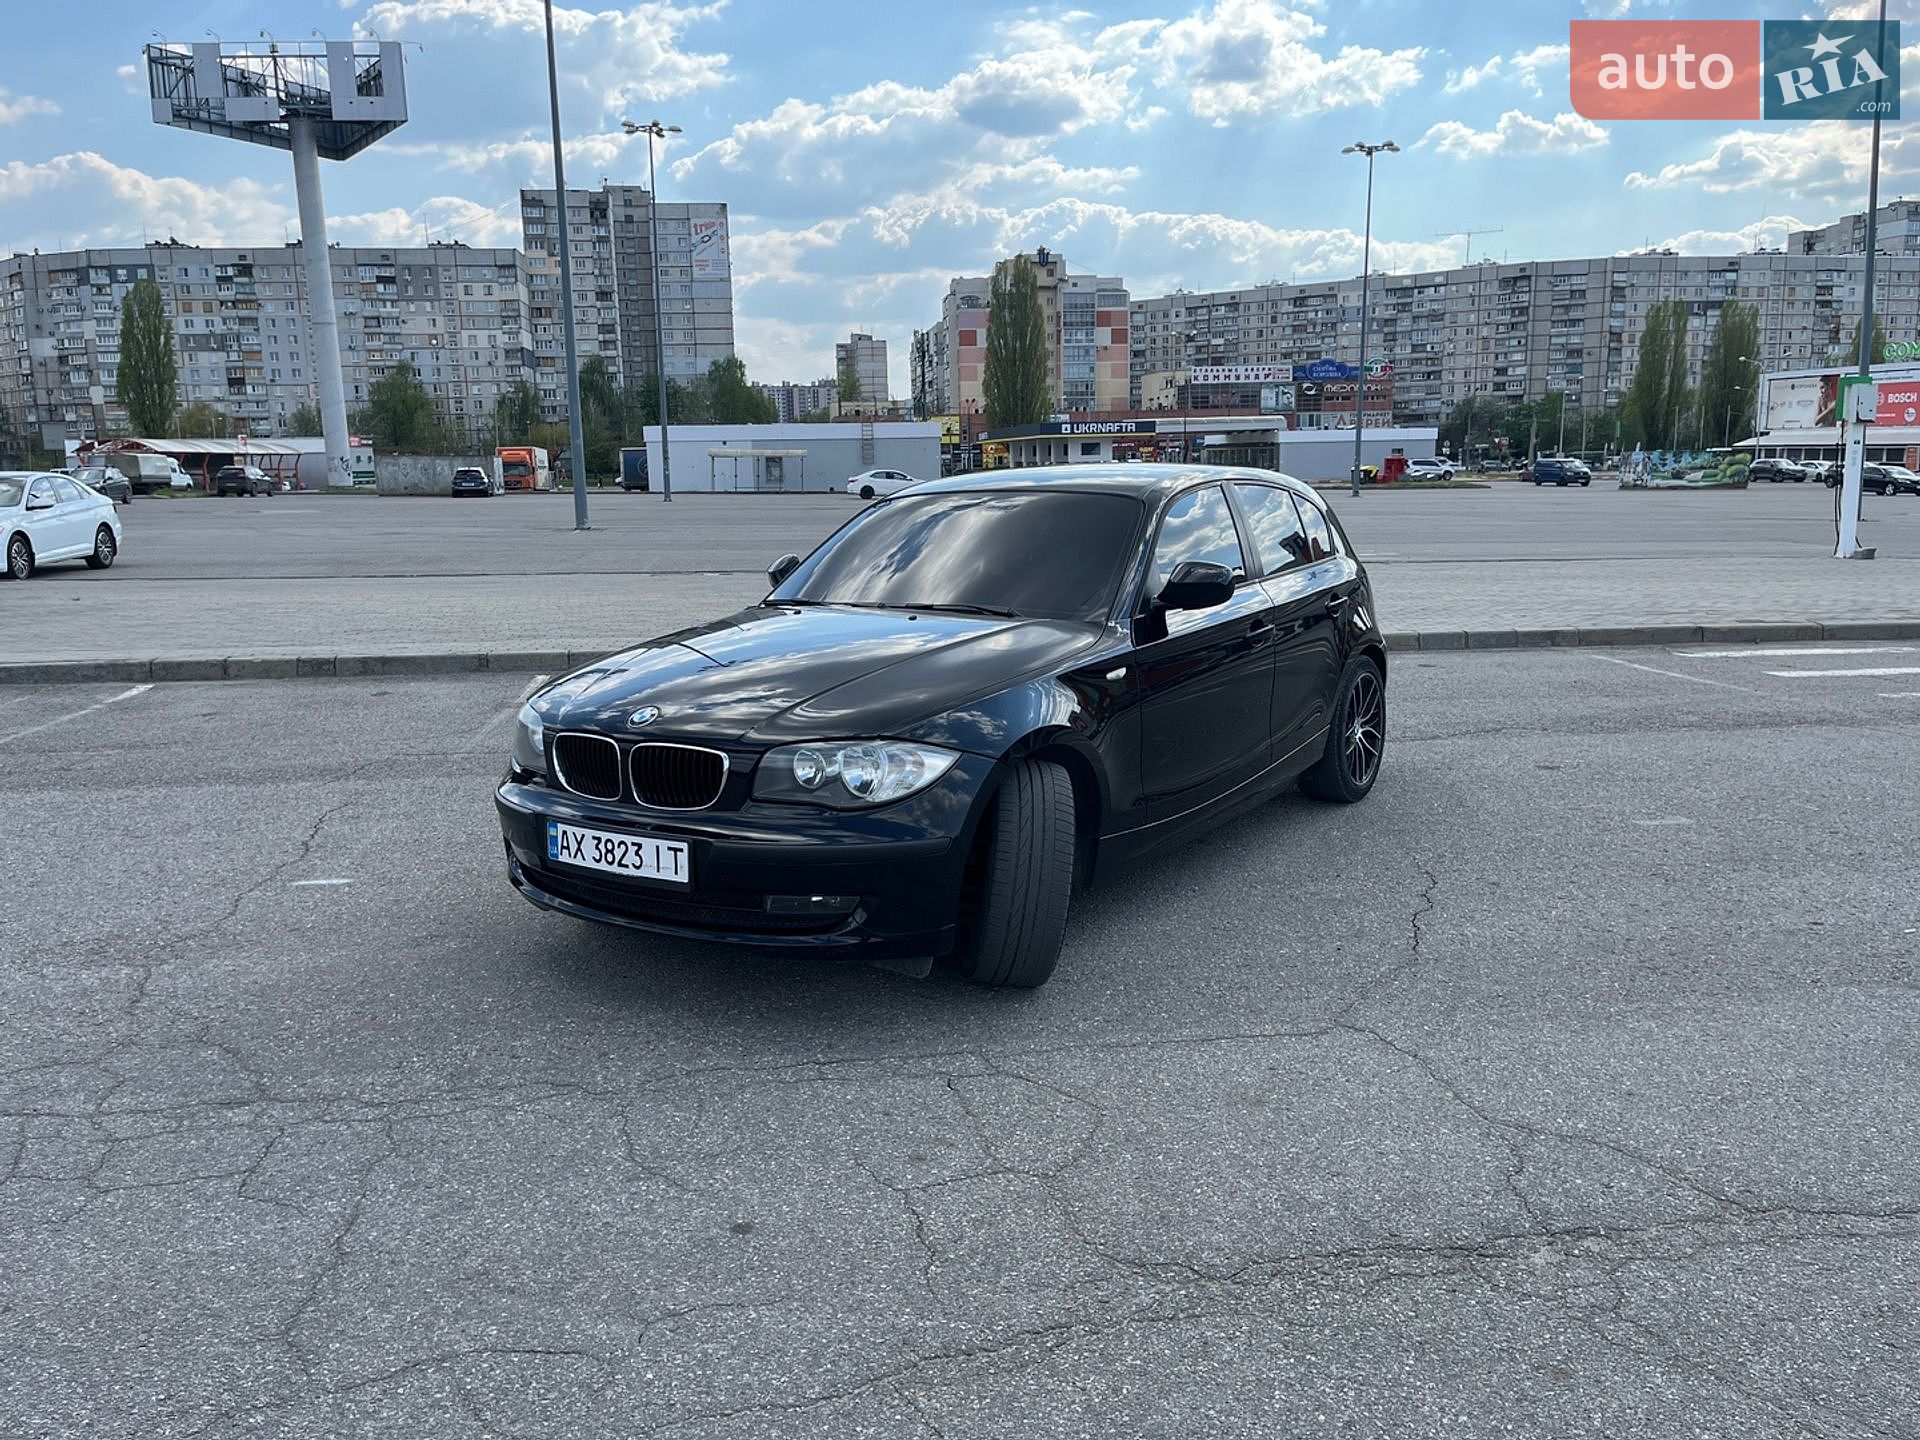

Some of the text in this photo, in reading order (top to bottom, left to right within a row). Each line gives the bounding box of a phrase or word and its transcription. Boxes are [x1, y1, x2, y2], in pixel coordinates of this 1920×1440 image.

[1193, 373, 1272, 381] КОММУНАР
[1888, 392, 1917, 403] BOSCH
[1073, 422, 1136, 433] UKRNAFTA
[559, 829, 684, 876] AX 3823 IT
